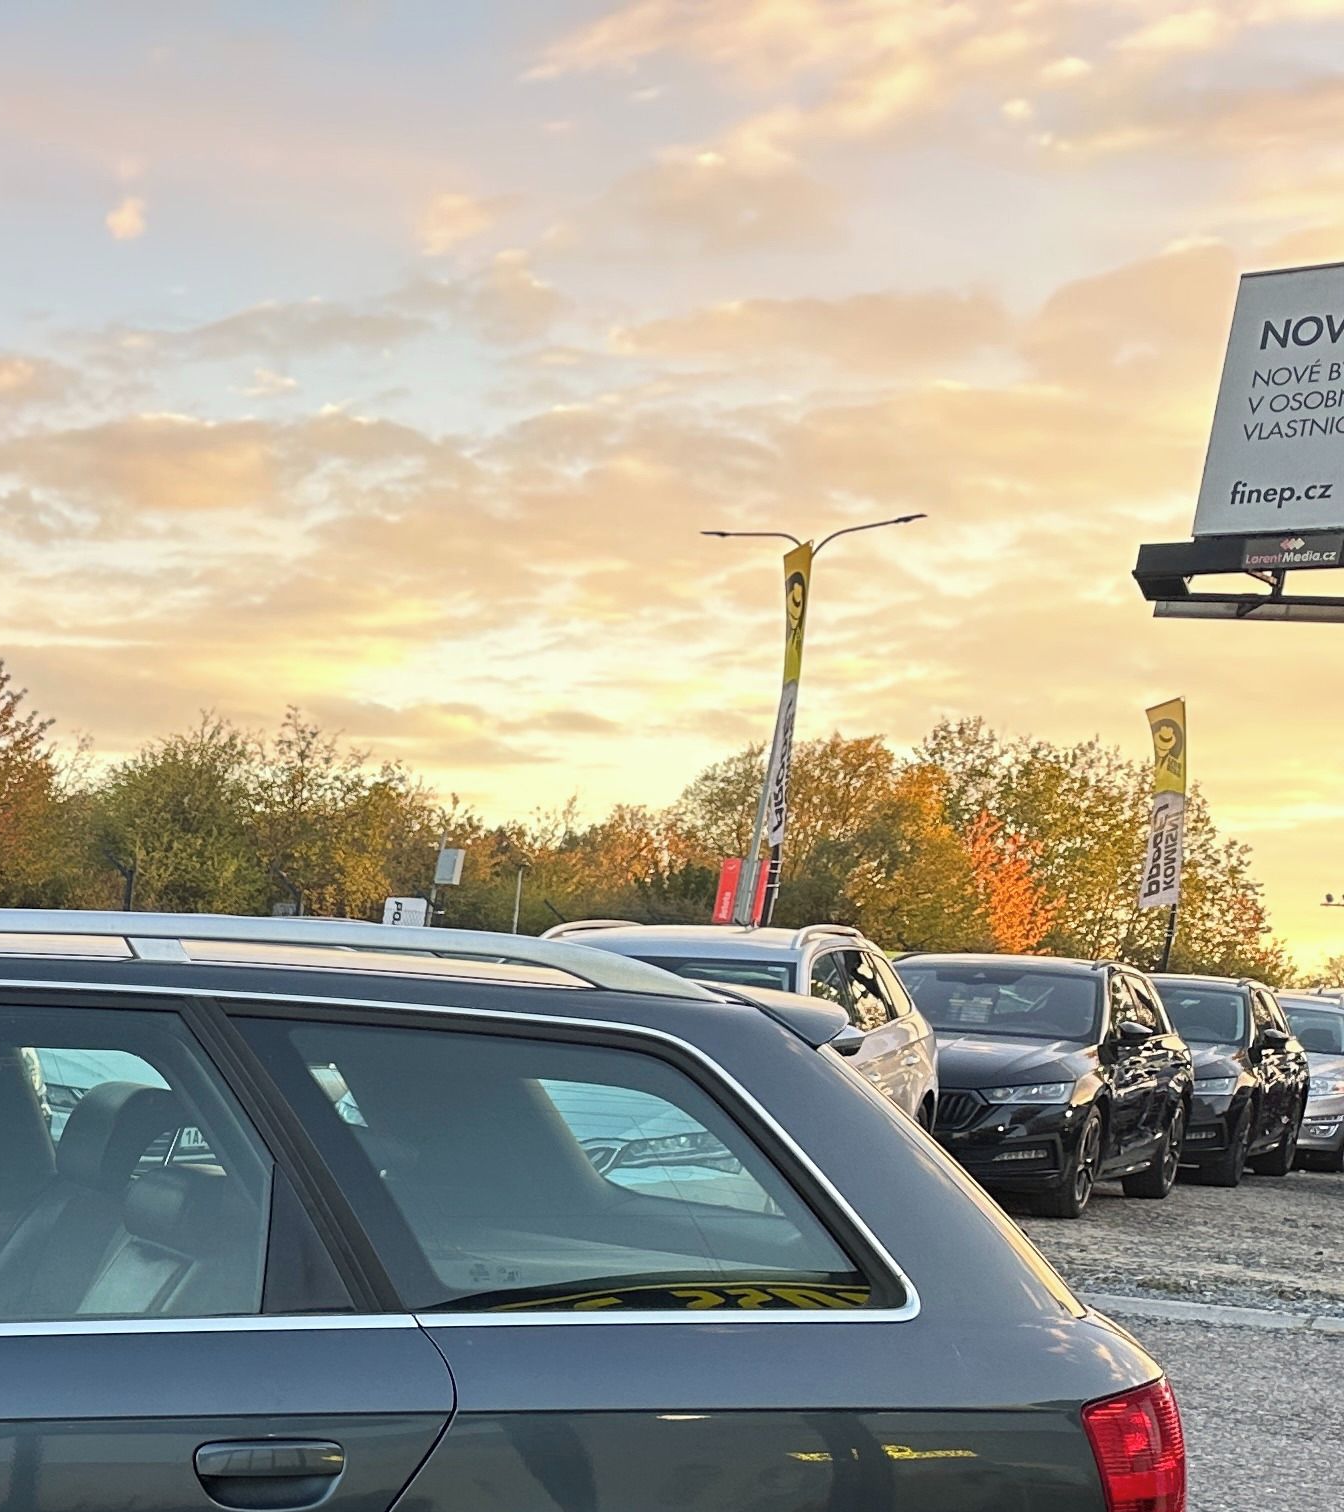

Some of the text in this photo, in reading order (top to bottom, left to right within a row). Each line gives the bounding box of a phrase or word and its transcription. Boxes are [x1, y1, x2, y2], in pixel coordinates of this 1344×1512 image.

[1251, 358, 1322, 389] NOVÉ
[1248, 396, 1265, 415] V
[1230, 480, 1334, 510] finep.cz
